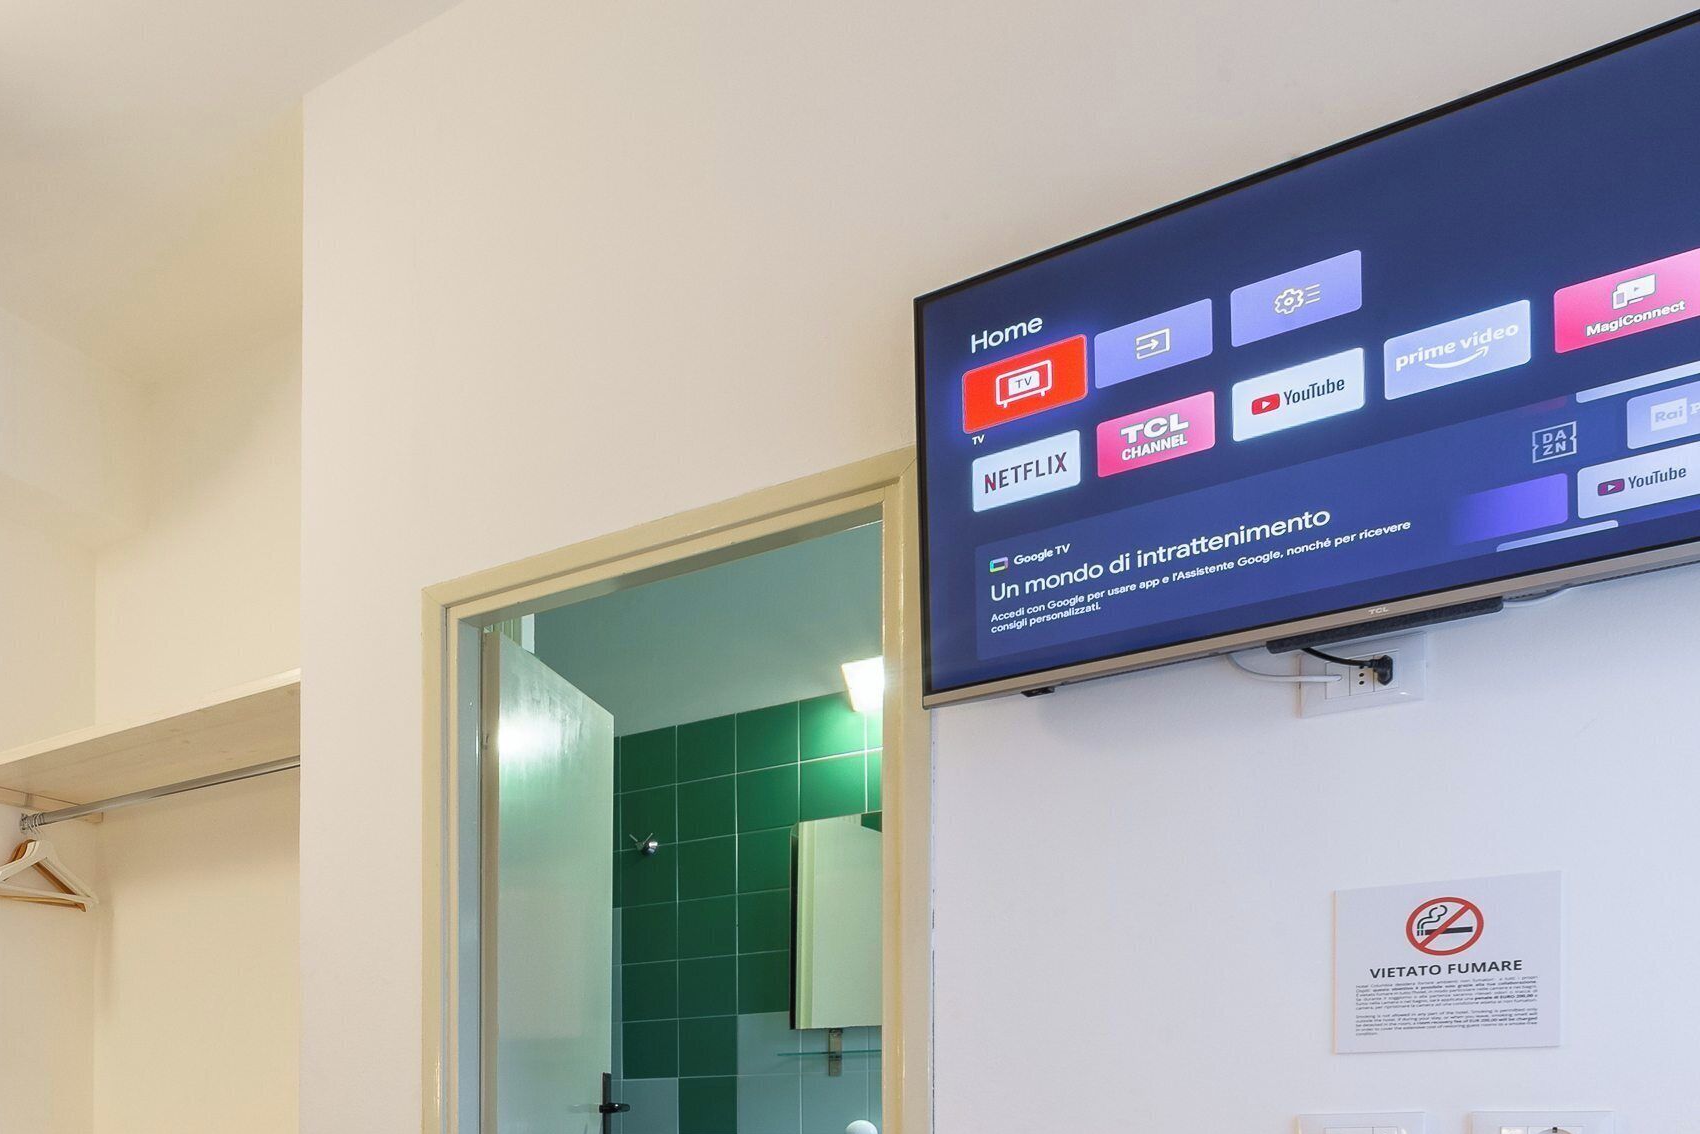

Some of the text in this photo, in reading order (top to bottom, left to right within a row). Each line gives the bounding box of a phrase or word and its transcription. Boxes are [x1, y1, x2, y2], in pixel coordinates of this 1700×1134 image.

[1585, 300, 1686, 337] MagiConnect
[971, 317, 1043, 354] Home
[1395, 324, 1519, 372] prime video
[1015, 376, 1032, 389] TV
[1283, 378, 1345, 406] YouTube
[1120, 413, 1189, 444] TCL
[1654, 406, 1683, 423] Rai
[972, 435, 985, 446] TV
[1121, 433, 1188, 461] CHANNEL
[984, 452, 1067, 494] NETFLIX
[1628, 467, 1687, 489] YouTube
[990, 510, 1331, 602] Un mondo di intrattenimento
[1013, 543, 1071, 565] Google TV
[990, 604, 1025, 623] Accedi
[1026, 604, 1046, 615] con
[1047, 595, 1085, 611] Google
[1087, 590, 1106, 605] per
[1107, 583, 1137, 597] usare
[1139, 577, 1160, 592] app
[1161, 576, 1170, 584] e
[1237, 550, 1284, 567] Google,
[1286, 537, 1331, 556] nonché
[1334, 533, 1356, 548] per
[1359, 520, 1411, 540] ricevere
[990, 602, 1102, 634] consigli personalizzati.
[1368, 606, 1389, 615] TCL
[1369, 959, 1523, 979] VIETATO FUMARE
